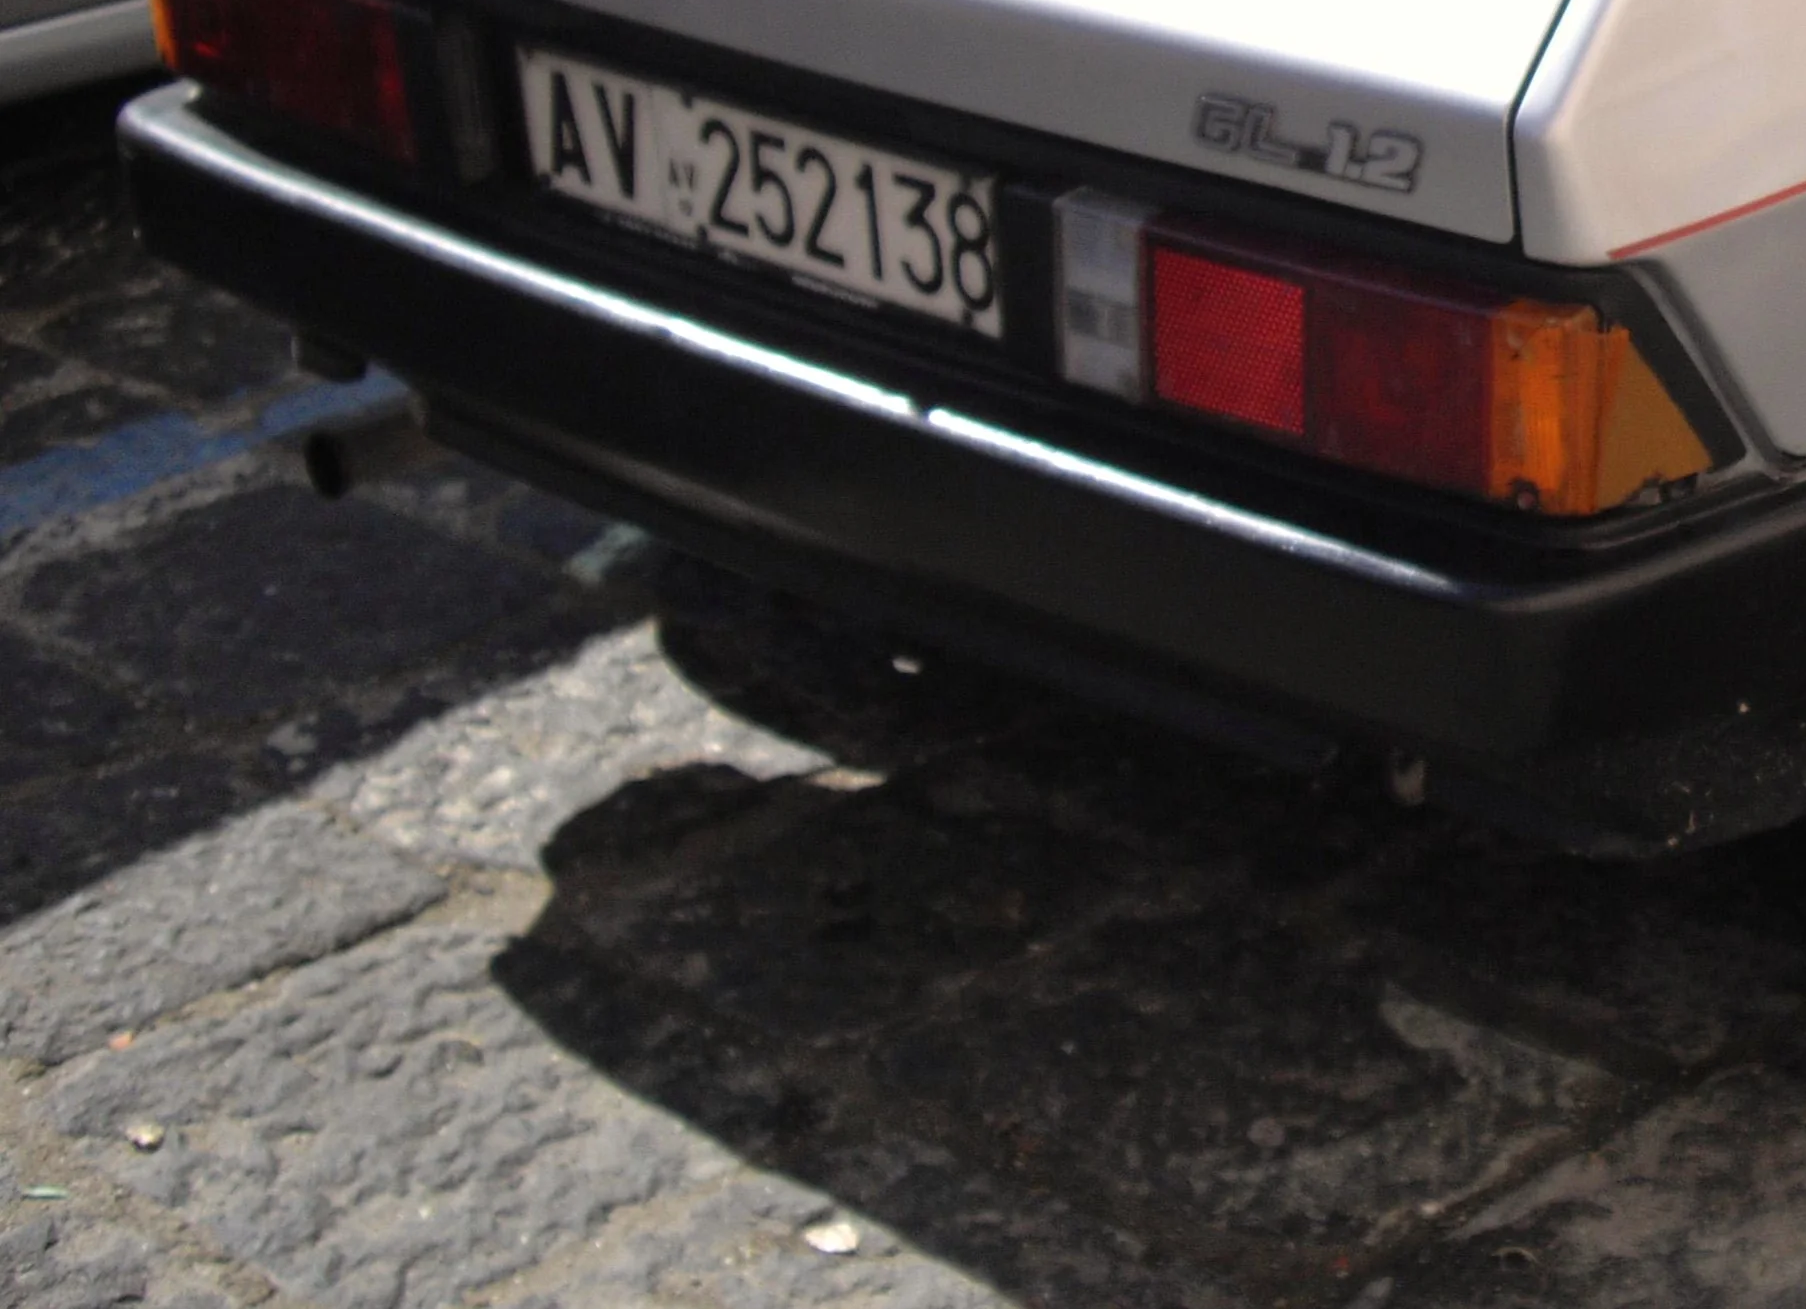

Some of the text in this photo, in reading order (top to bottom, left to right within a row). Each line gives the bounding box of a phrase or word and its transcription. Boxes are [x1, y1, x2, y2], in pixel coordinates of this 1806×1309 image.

[550, 72, 994, 310] AV 252138
[1194, 93, 1297, 167] GL
